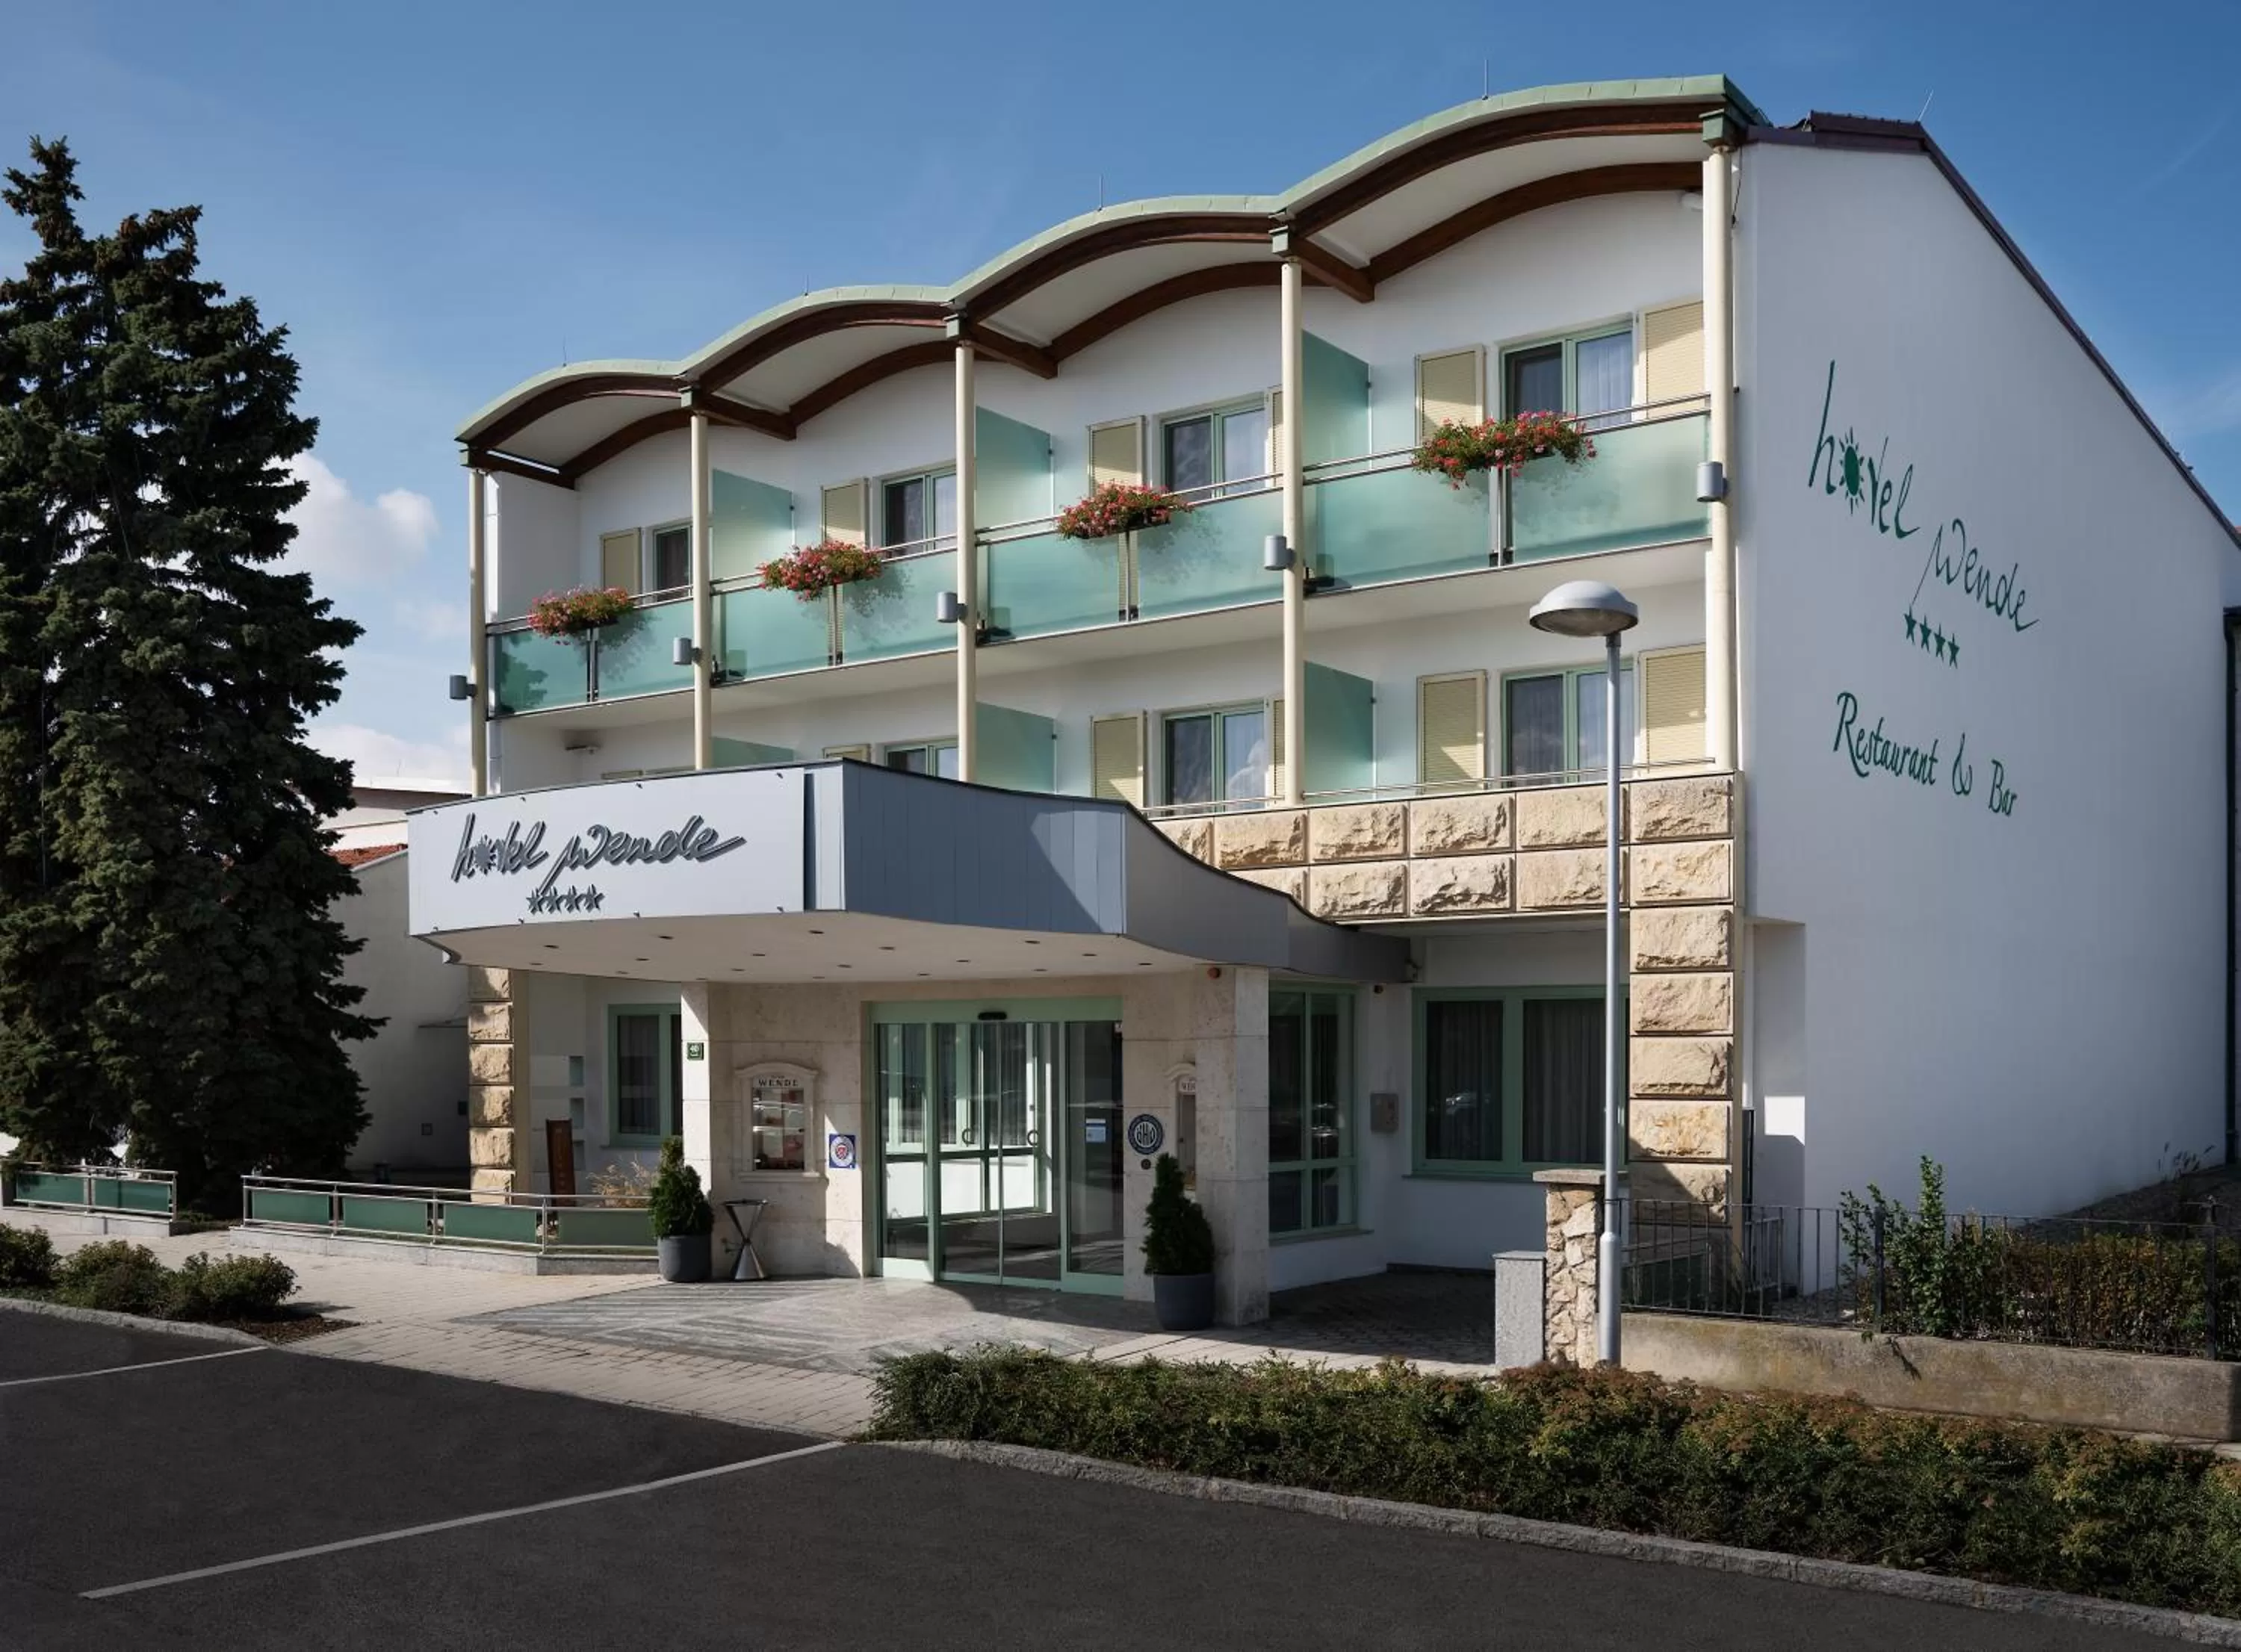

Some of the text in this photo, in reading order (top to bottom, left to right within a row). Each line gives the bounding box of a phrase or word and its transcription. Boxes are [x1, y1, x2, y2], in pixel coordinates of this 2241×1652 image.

[1910, 518, 2039, 632] Wende
[1834, 692, 1938, 786] Restaurant
[1989, 759, 2017, 816] Bar
[537, 815, 747, 896] Wende
[758, 1078, 799, 1087] WENDE
